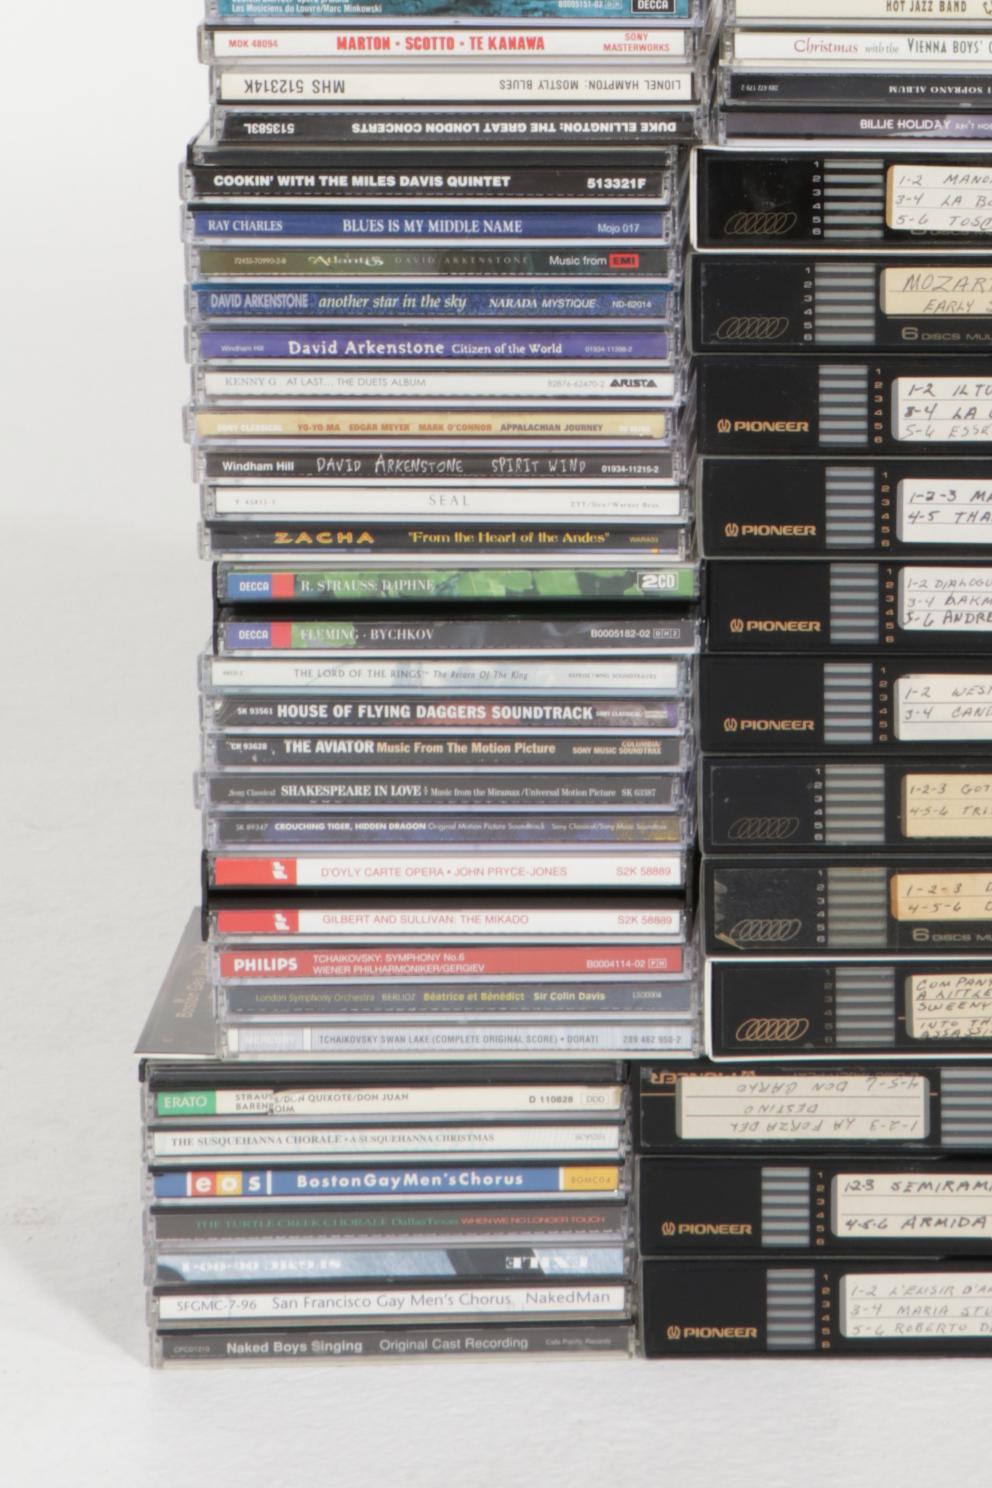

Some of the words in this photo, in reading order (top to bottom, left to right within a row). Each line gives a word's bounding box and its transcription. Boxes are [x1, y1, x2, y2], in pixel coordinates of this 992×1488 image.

[214, 176, 274, 186] COOKIN'
[278, 176, 315, 186] WITH
[319, 176, 348, 186] THE
[352, 176, 396, 187] MILES
[400, 176, 444, 187] DAVIS
[448, 176, 510, 188] QUINTET
[208, 220, 230, 231] RAY
[232, 220, 283, 231] CHARLES
[288, 340, 338, 355] David
[345, 340, 445, 355] Arkenstone
[734, 421, 809, 432] PIONEER
[277, 705, 328, 719] HOUSE
[333, 706, 354, 719] OF
[358, 706, 410, 719] FLYING
[416, 706, 486, 720] DAGGERS
[492, 706, 593, 721] SOUNDTRACK
[234, 959, 297, 971] PHILIPS
[164, 1096, 207, 1109] ERATO
[272, 1295, 298, 1309] San
[303, 1294, 371, 1309] Francisco
[377, 1294, 405, 1310] Gay
[411, 1293, 455, 1307] Men's
[459, 1292, 511, 1306] Chorus
[683, 1326, 757, 1338] PIONEER
